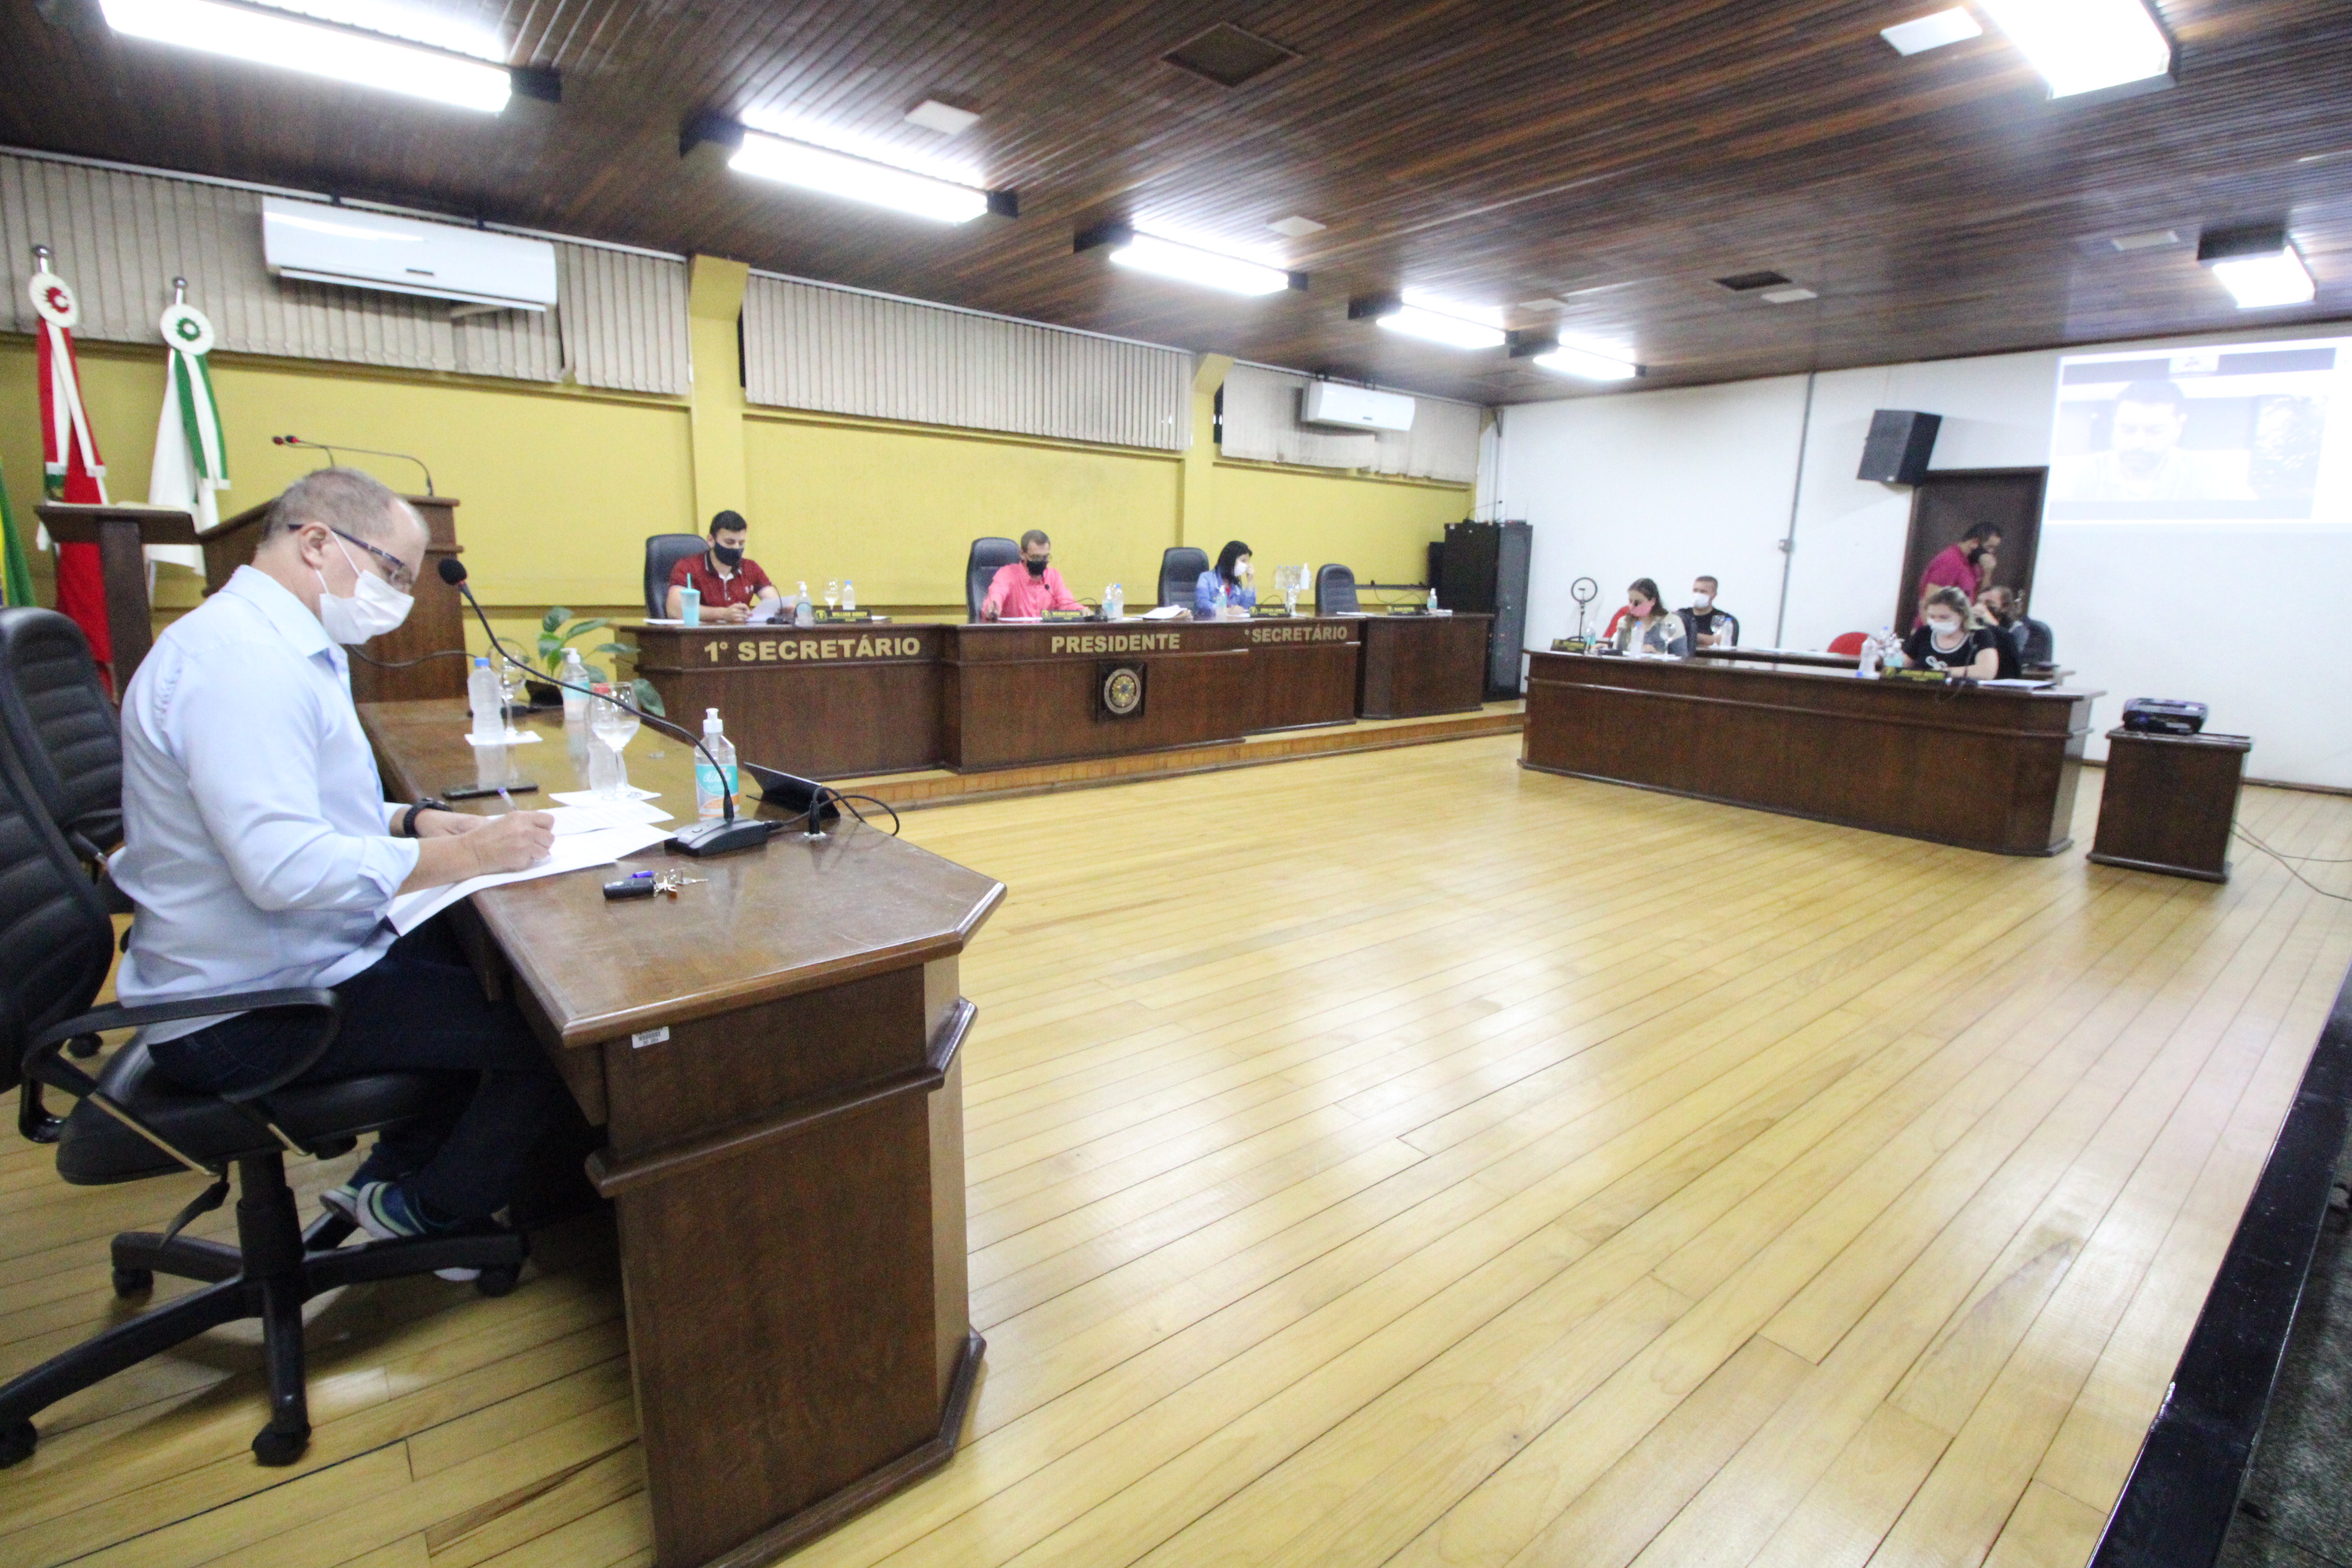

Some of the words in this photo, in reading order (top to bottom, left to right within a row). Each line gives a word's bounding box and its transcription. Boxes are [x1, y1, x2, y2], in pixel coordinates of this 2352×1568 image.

[1051, 633, 1181, 654] PRESIDENTE
[1251, 623, 1348, 643] SECRETÁRIO
[737, 635, 921, 662] SECRETÁRIO
